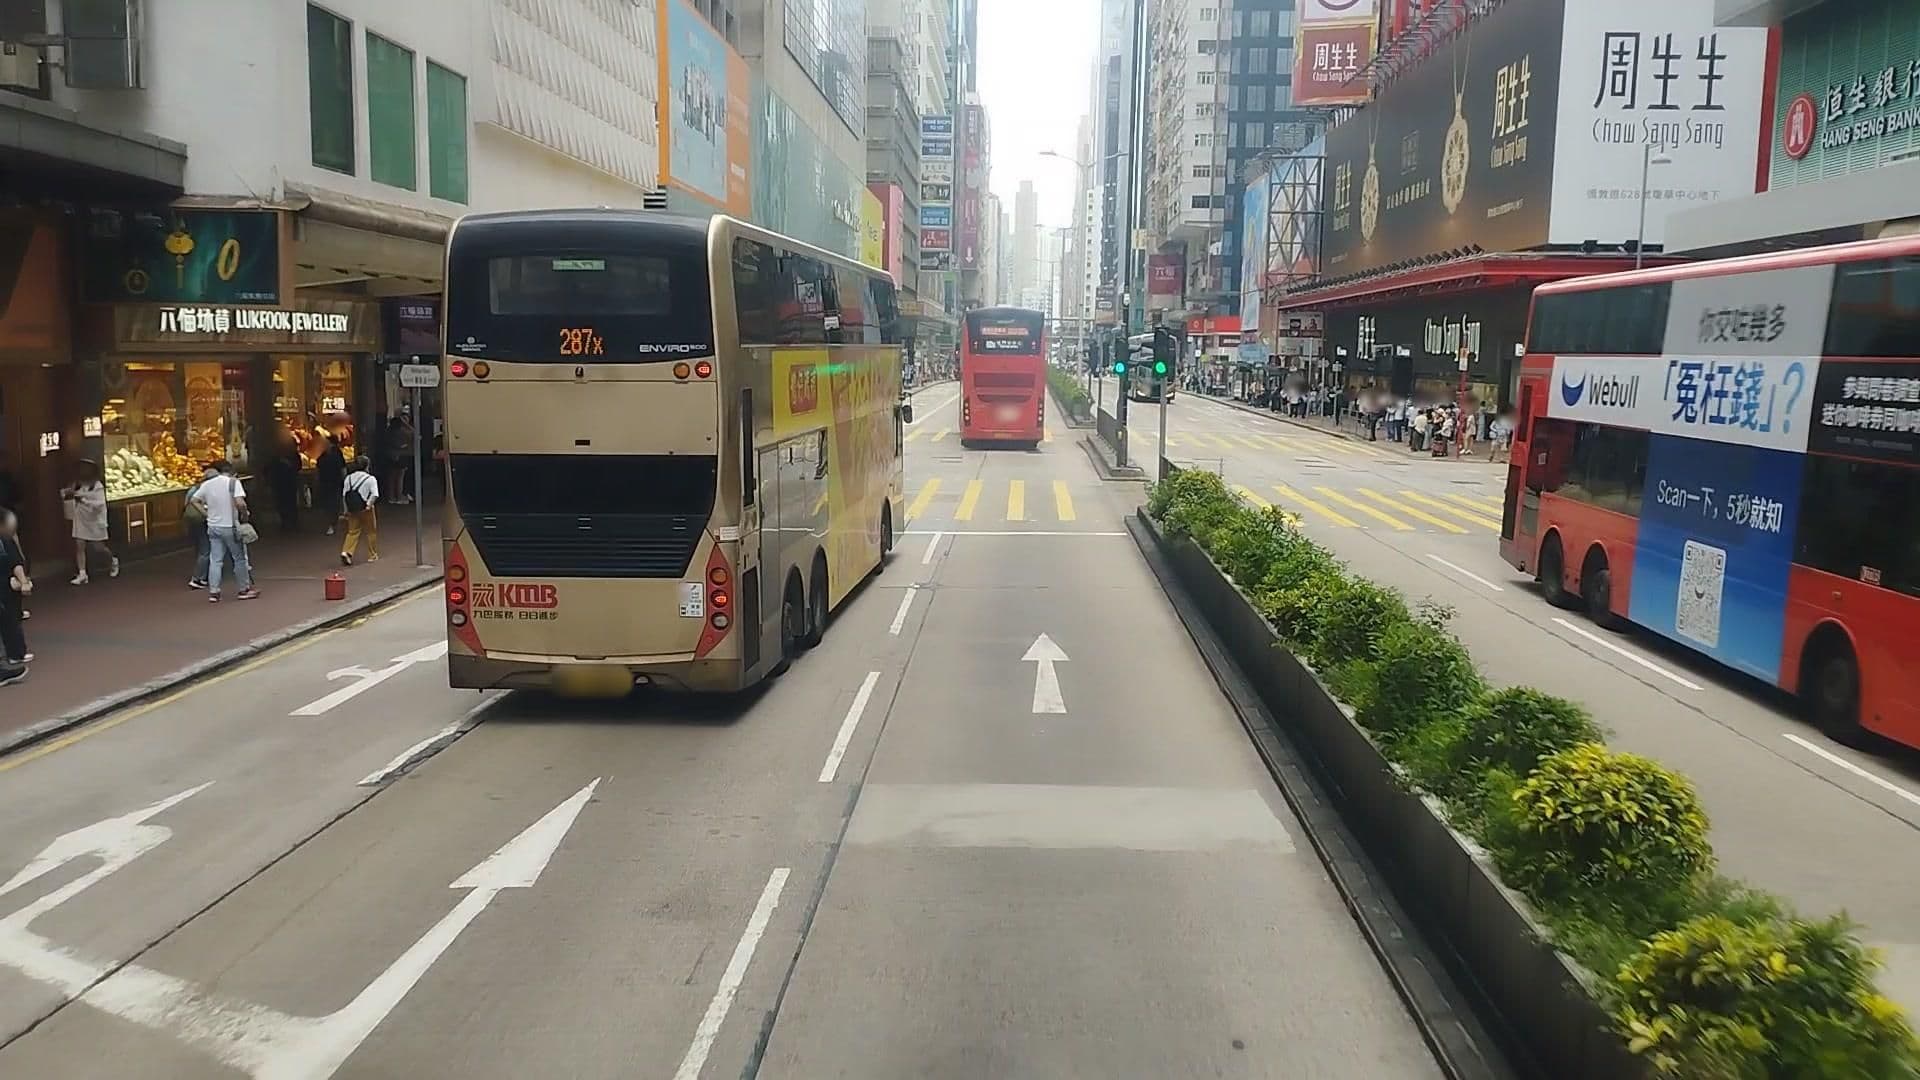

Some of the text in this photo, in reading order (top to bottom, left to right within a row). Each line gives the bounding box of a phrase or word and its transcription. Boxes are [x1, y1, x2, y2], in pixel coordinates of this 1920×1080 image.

[1313, 42, 1357, 70] 周生生
[1594, 32, 1727, 110] 周生生
[1492, 54, 1530, 139] 周生生
[1822, 60, 1920, 122] 恒生銀行
[1593, 117, 1724, 149] Chow Sang Sang
[1822, 108, 1920, 148] HANG SENG BANK
[235, 309, 349, 334] LUKFOOK JEWELLERY
[1589, 374, 1640, 409] Webull
[499, 584, 558, 608] KMB
[473, 610, 559, 620] 九巴服務 日日進步
